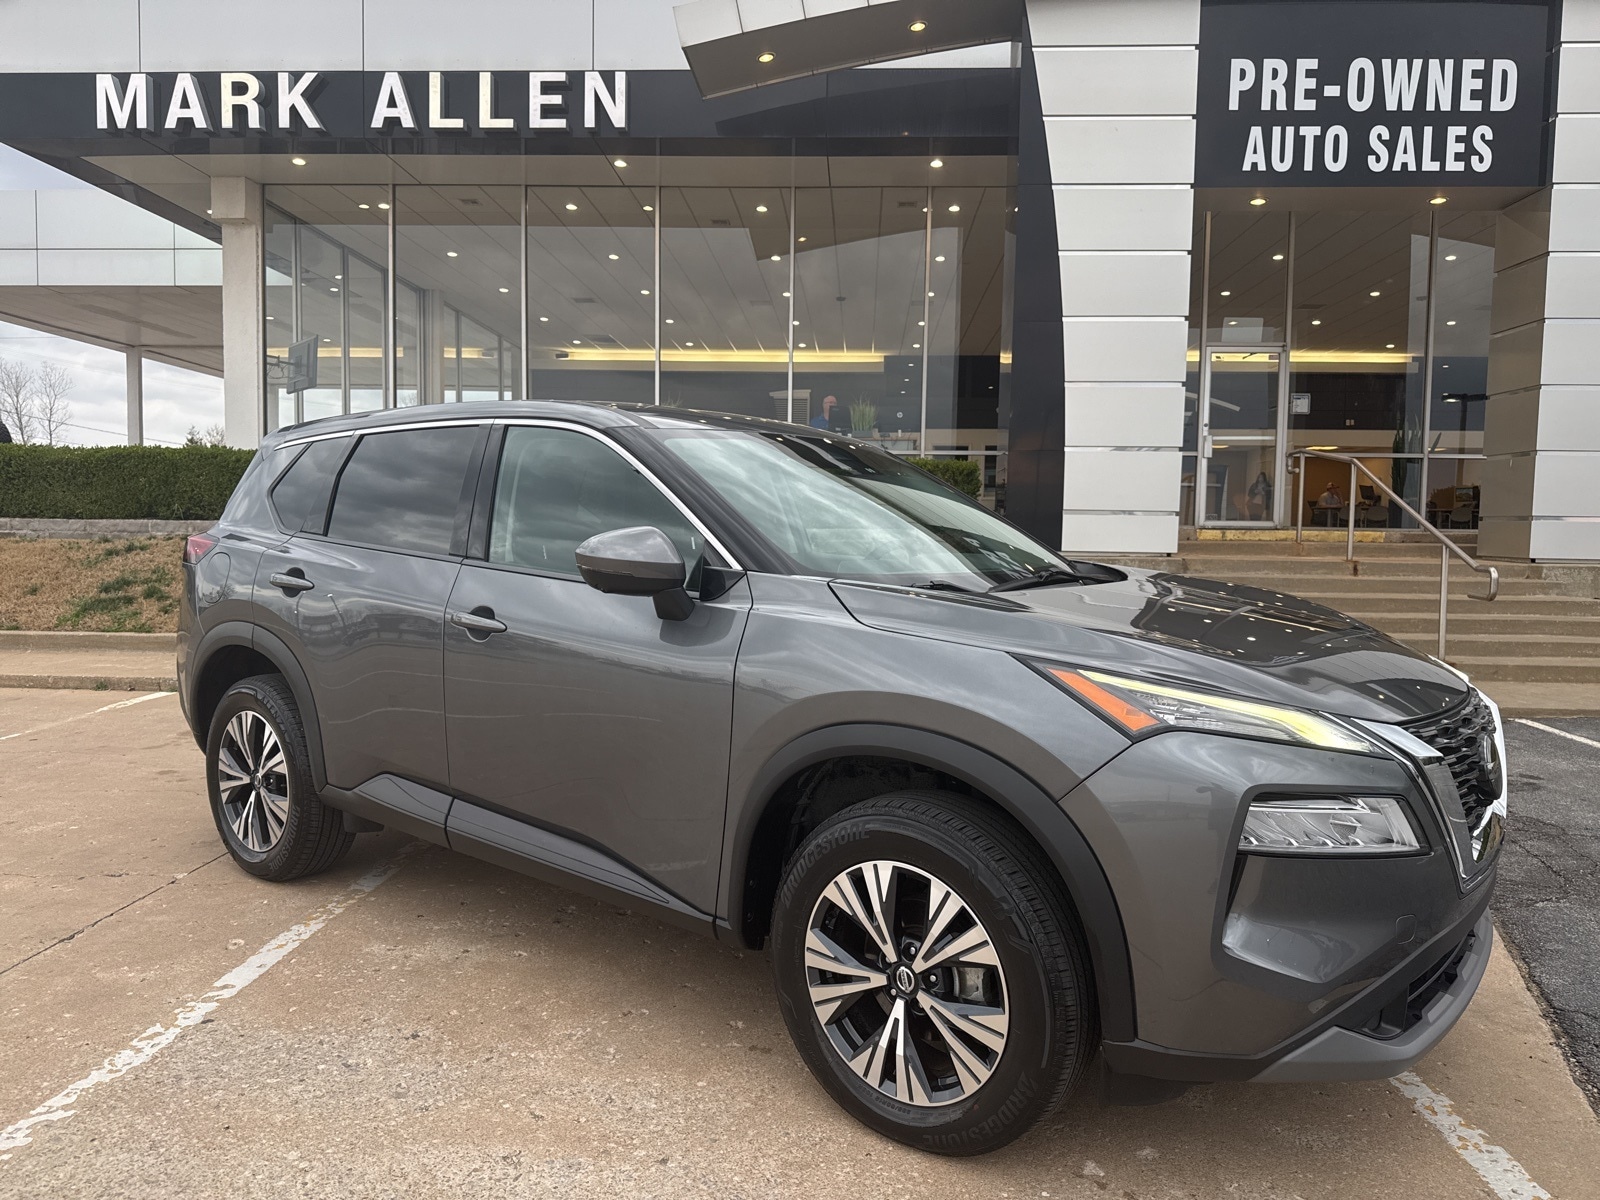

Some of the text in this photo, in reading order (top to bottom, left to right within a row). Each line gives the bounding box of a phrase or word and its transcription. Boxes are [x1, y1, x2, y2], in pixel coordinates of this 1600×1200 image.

[95, 71, 628, 129] MARK ALLEN
[1228, 57, 1519, 112] PRE-OWNED
[1241, 124, 1494, 173] AUTO SALES
[267, 804, 302, 873] BRIDGESTONE
[779, 821, 871, 910] BRIDGESTONE
[922, 1070, 1040, 1147] BRIDGESTONE
